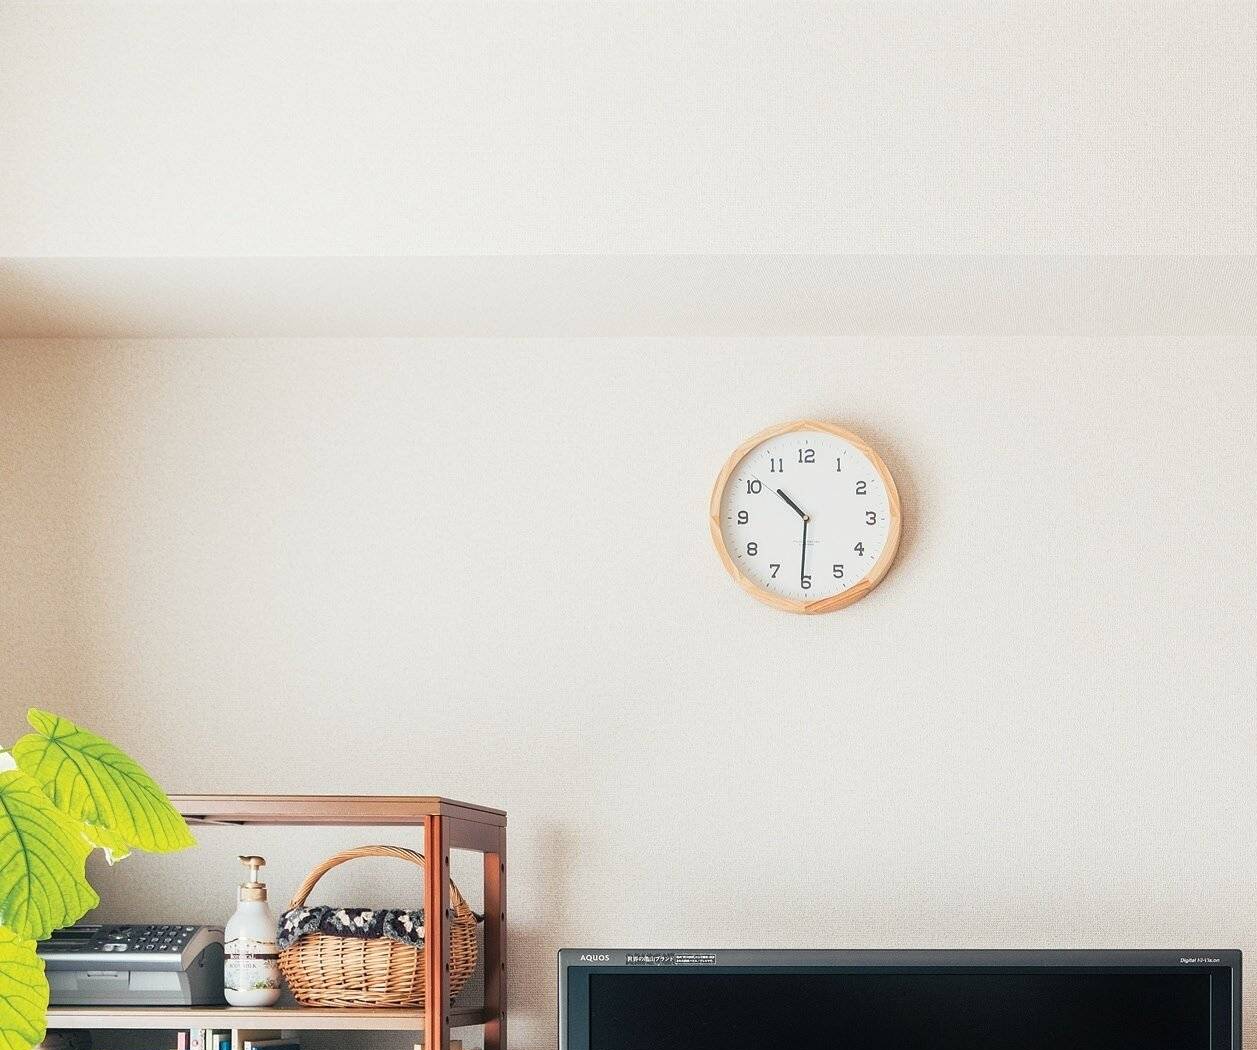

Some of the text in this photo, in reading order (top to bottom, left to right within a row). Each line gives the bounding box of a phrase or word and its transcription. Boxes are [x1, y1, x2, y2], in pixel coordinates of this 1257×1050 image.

[798, 448, 815, 463] 12
[770, 458, 784, 473] 11
[836, 457, 842, 472] 1
[746, 479, 762, 494] 10
[855, 480, 867, 495] 2
[737, 510, 749, 525] 9
[865, 511, 877, 526] 3
[746, 542, 758, 556] 8
[853, 541, 865, 556] 4
[769, 564, 780, 578] 7
[832, 564, 844, 579] 5
[800, 575, 812, 589] 6
[580, 954, 610, 962] AQUOS
